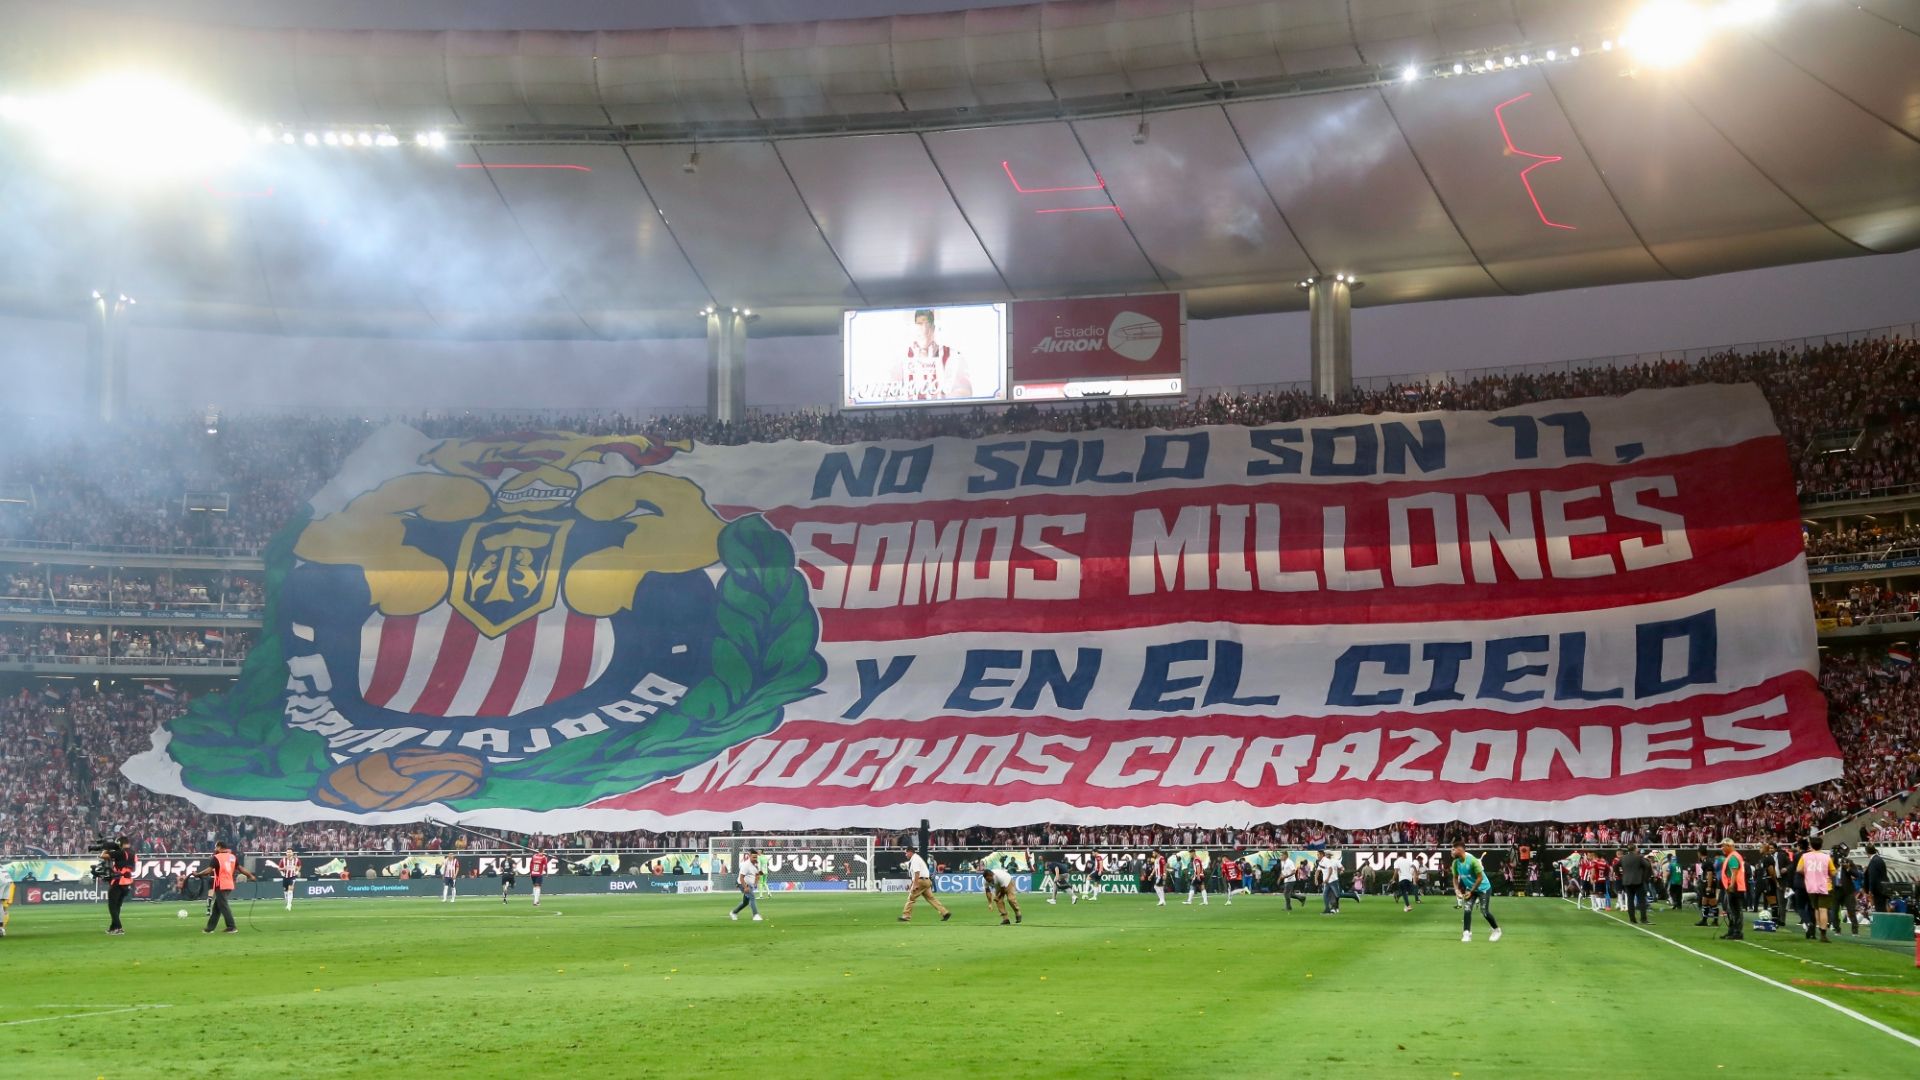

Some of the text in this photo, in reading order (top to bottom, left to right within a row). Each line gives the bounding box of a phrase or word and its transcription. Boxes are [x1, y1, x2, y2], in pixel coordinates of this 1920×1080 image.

[1054, 325, 1105, 338] Estadio
[1031, 336, 1103, 353] AKRON
[811, 444, 934, 500] NO
[967, 431, 1210, 494] SOLO
[1247, 419, 1446, 476] SON
[791, 475, 1694, 610] SOMOS MILLONES
[840, 608, 1717, 719] Y EN EL CIELO
[670, 695, 1792, 793] MUCHOS CORAZONES
[479, 857, 560, 875] FUUE
[610, 881, 637, 890] BBVA
[1100, 874, 1134, 882] OPULAR
[42, 888, 109, 901] caliente.m
[308, 885, 335, 895] BBVA
